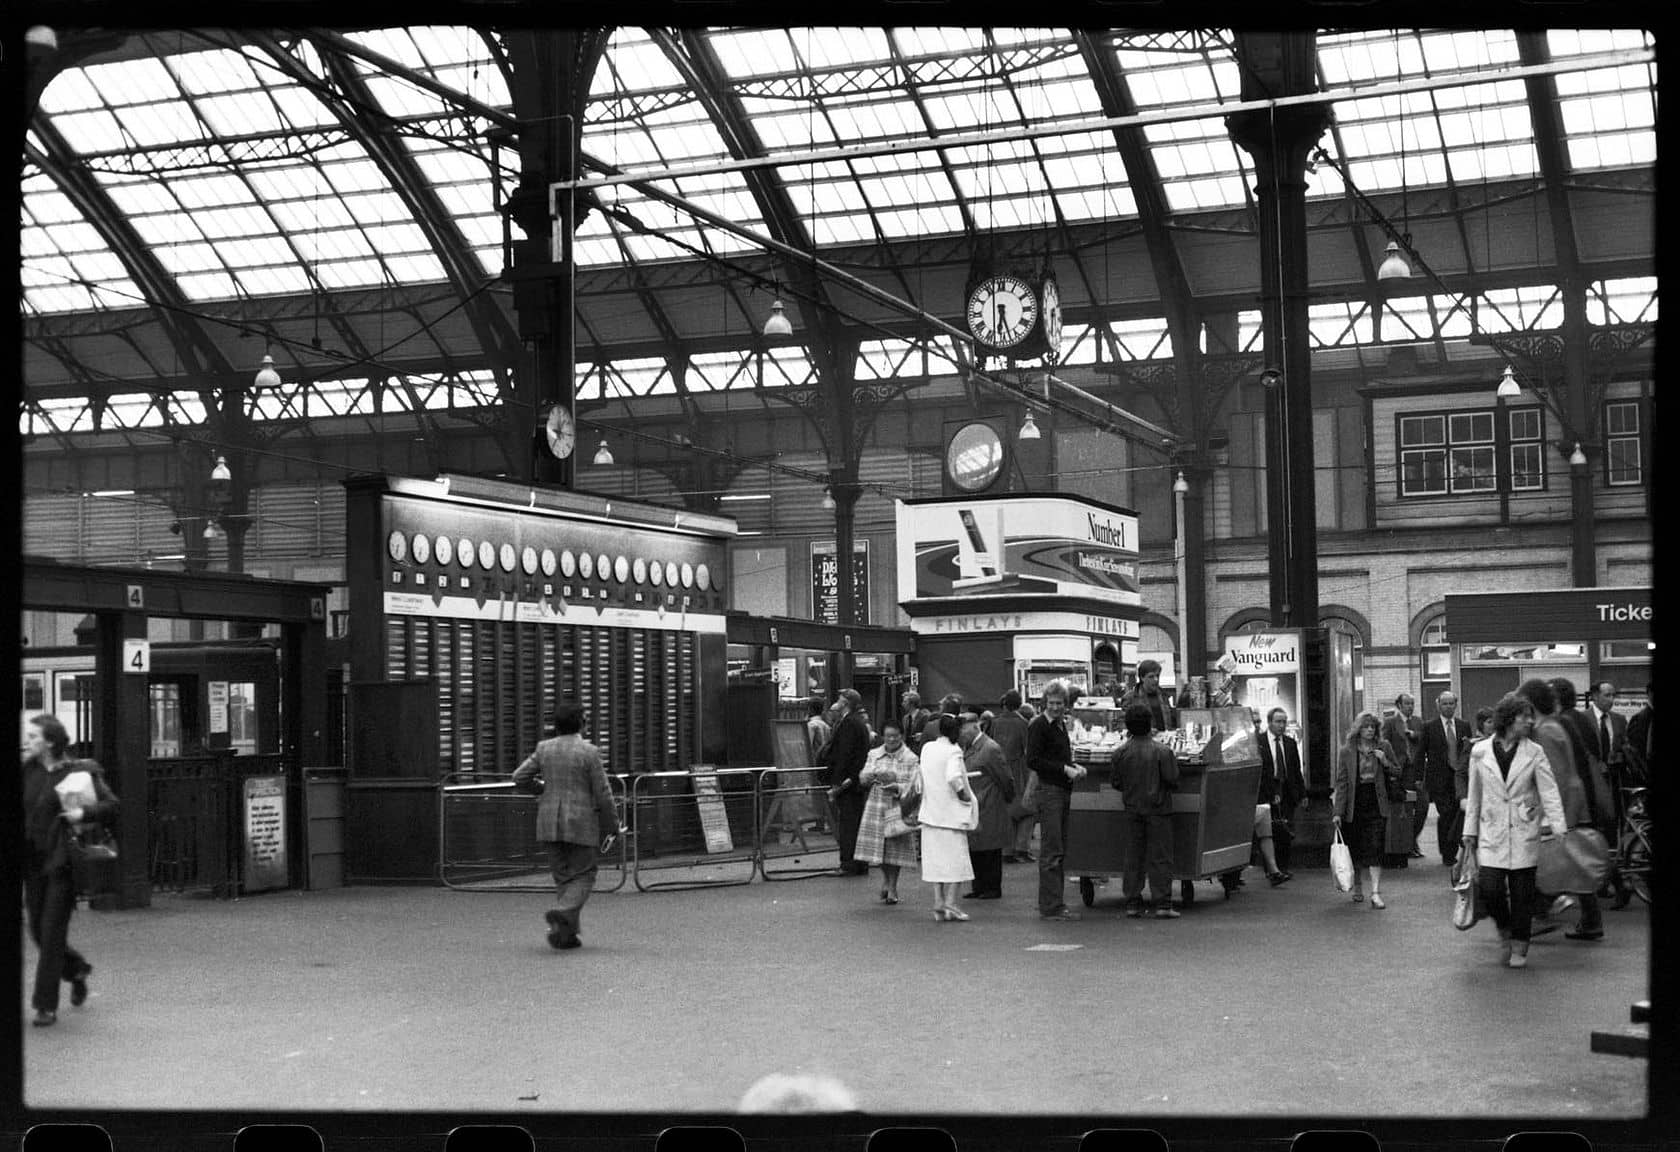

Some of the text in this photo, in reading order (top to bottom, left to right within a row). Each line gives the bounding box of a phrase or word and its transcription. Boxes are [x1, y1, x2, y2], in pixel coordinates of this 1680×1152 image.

[130, 588, 141, 605] 4
[313, 600, 322, 616] 4
[1596, 603, 1653, 621] Ticke
[935, 615, 1021, 632] FINLAYS
[1086, 615, 1128, 635] FINLAYS
[1249, 634, 1277, 649] New
[131, 650, 144, 670] 4
[1231, 647, 1296, 670] Vanguard
